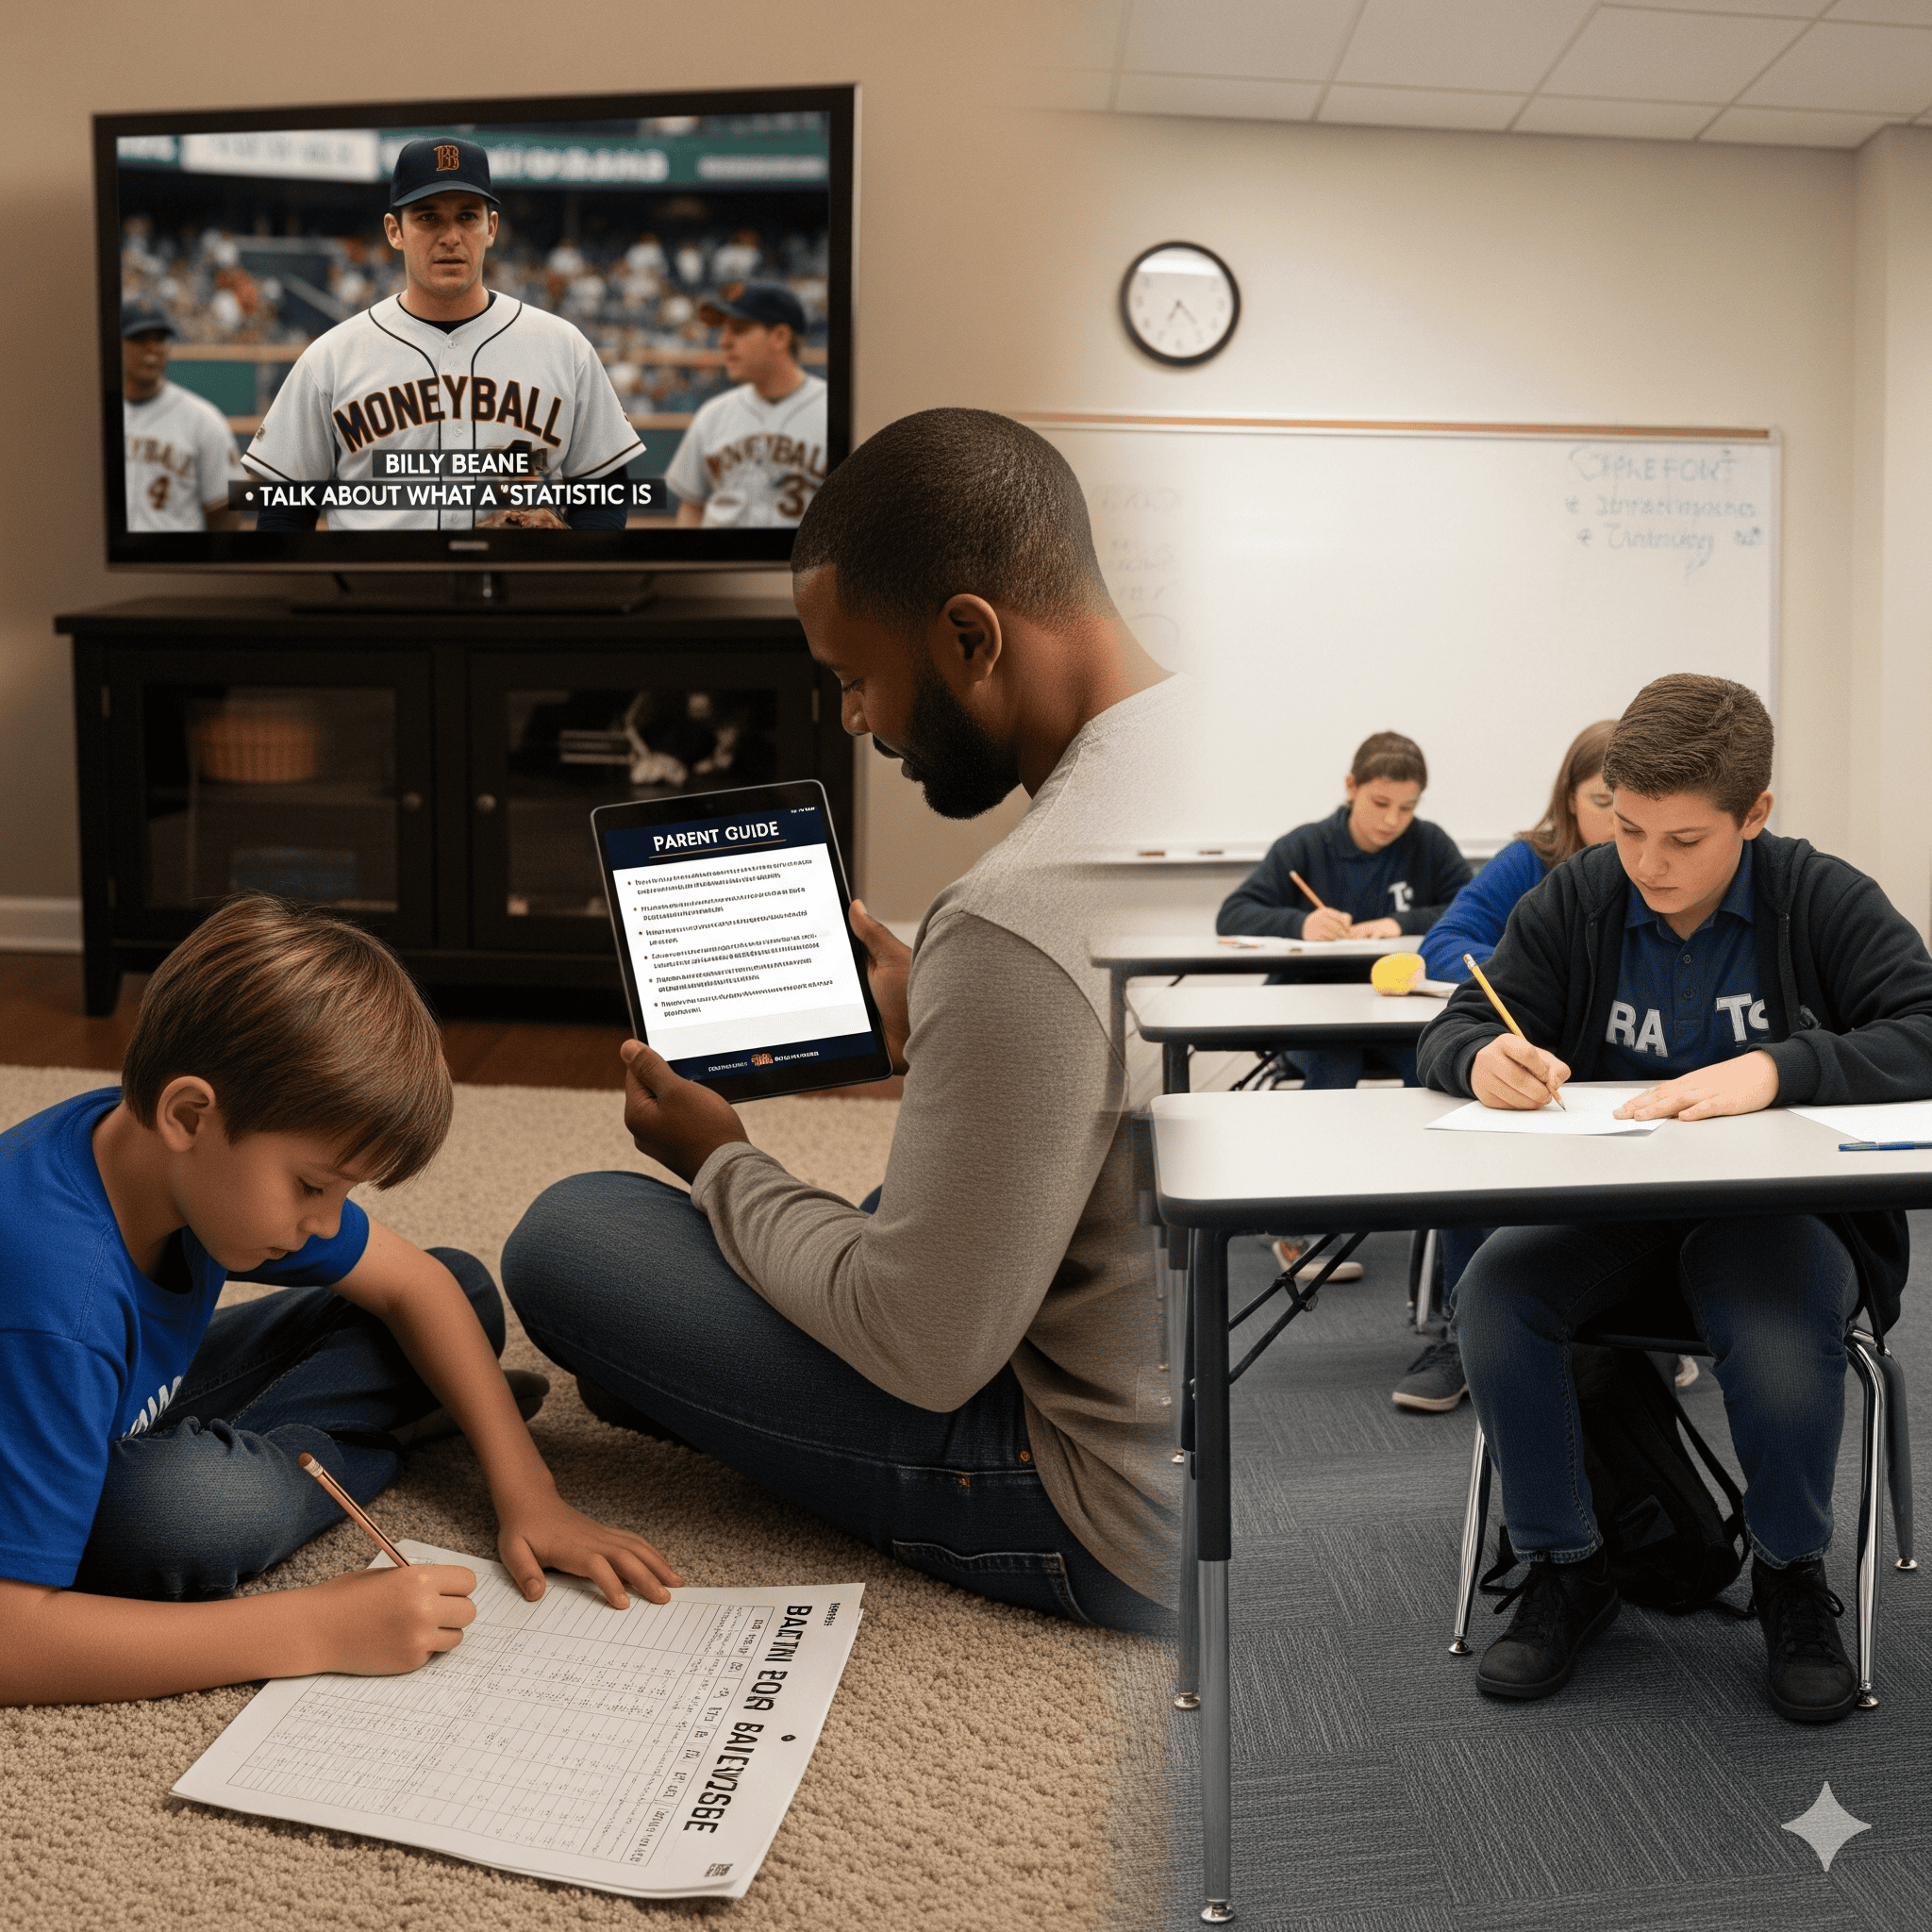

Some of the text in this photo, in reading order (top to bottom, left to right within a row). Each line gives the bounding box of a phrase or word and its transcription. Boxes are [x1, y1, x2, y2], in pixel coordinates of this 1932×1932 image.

[333, 375, 562, 454] MONEYBALL
[386, 453, 529, 474] BILLY BEANE
[259, 486, 316, 507] TALK
[322, 486, 401, 506] ABOUT
[407, 485, 475, 506] WHAT
[479, 485, 497, 506] A
[633, 484, 652, 505] IS
[653, 821, 780, 852] PARENT GUIDE
[1606, 1000, 1669, 1058] RA
